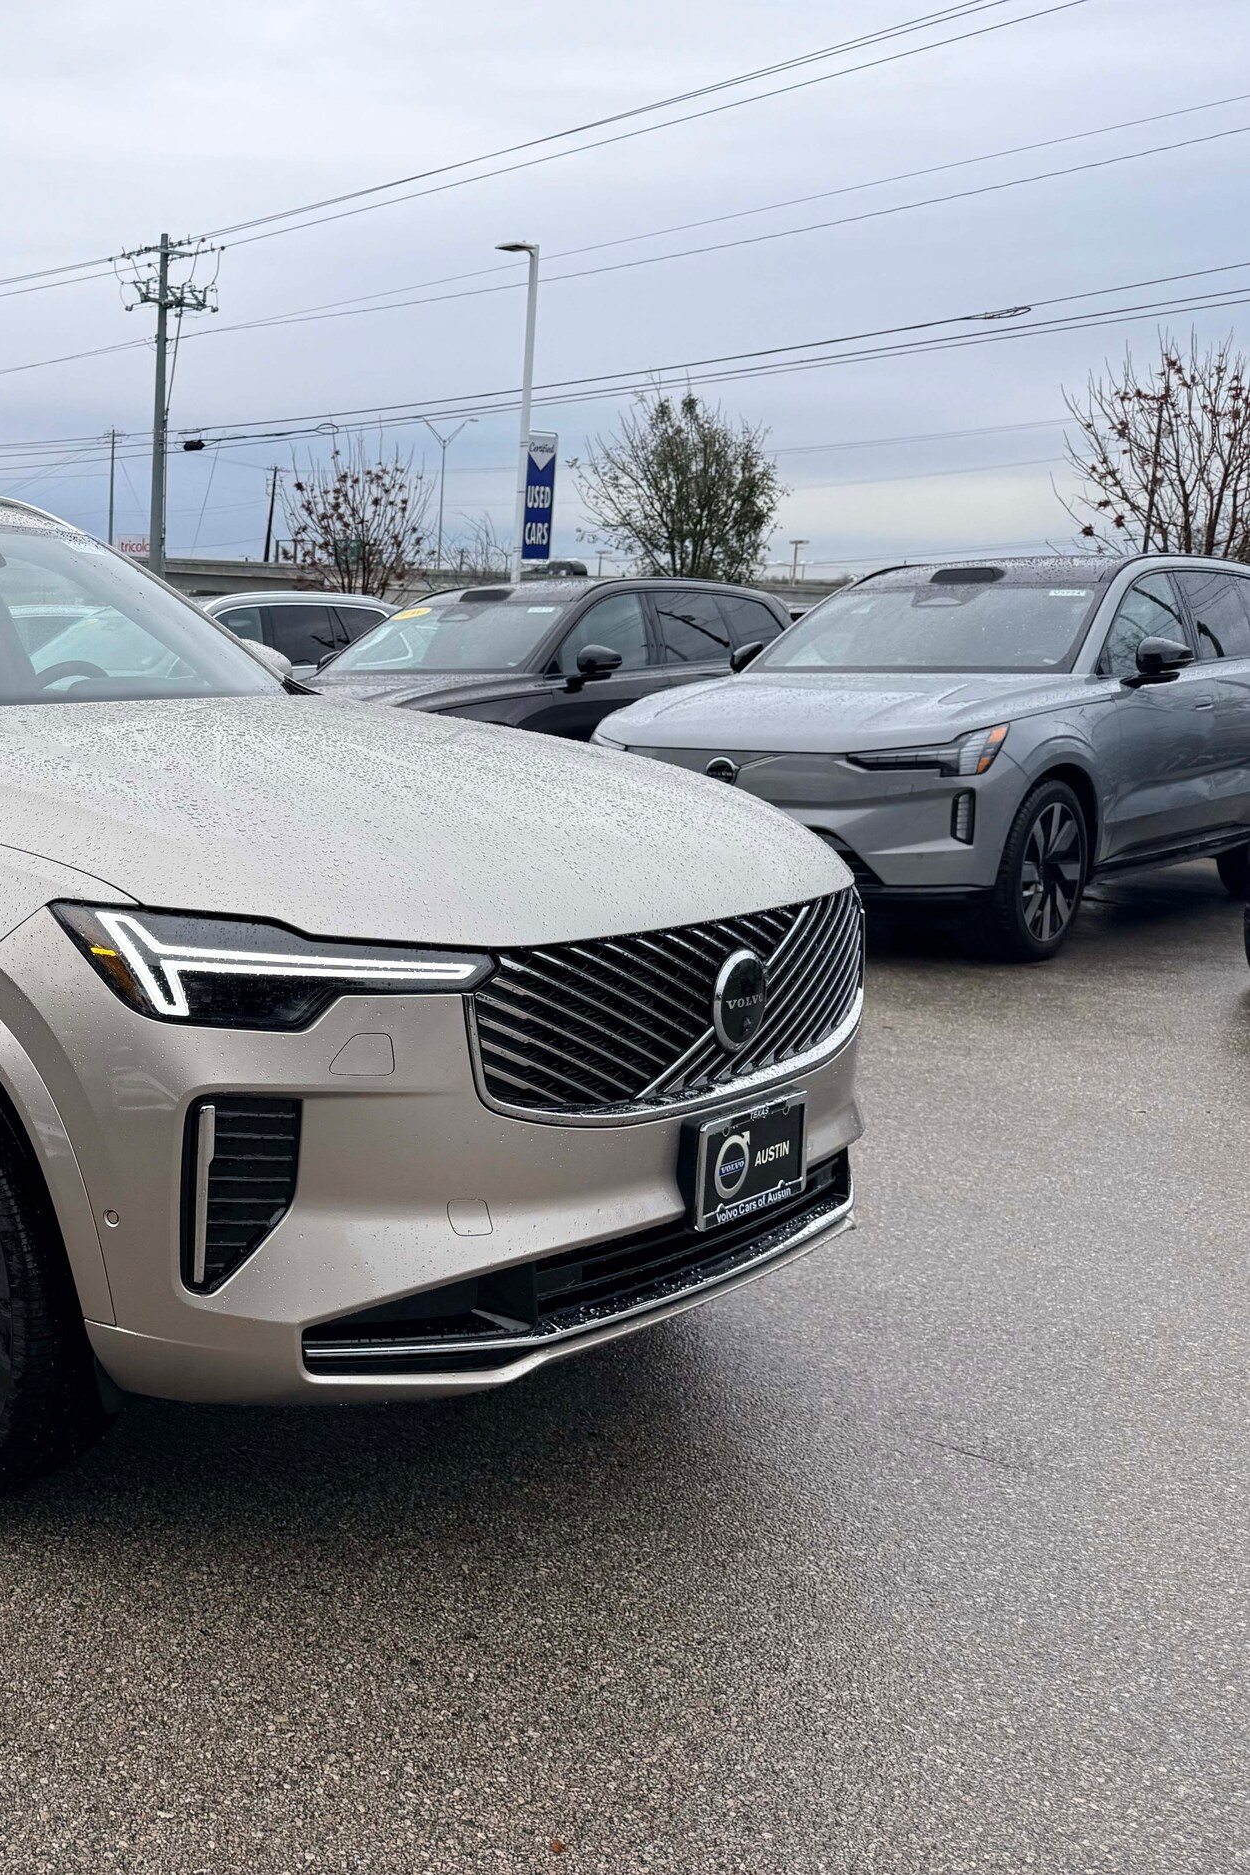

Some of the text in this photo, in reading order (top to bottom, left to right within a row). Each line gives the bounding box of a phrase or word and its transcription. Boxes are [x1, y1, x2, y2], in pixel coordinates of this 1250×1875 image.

[529, 441, 555, 454] Certified
[527, 485, 551, 509] USED
[524, 522, 549, 545] CARS
[726, 993, 764, 1010] VOLVO
[750, 1106, 770, 1121] TEXAS
[754, 1140, 790, 1167] AUSTIN
[720, 1160, 745, 1175] VOLVO
[716, 1209, 738, 1223] Volvo
[738, 1201, 757, 1215] Cars
[757, 1194, 768, 1207] of
